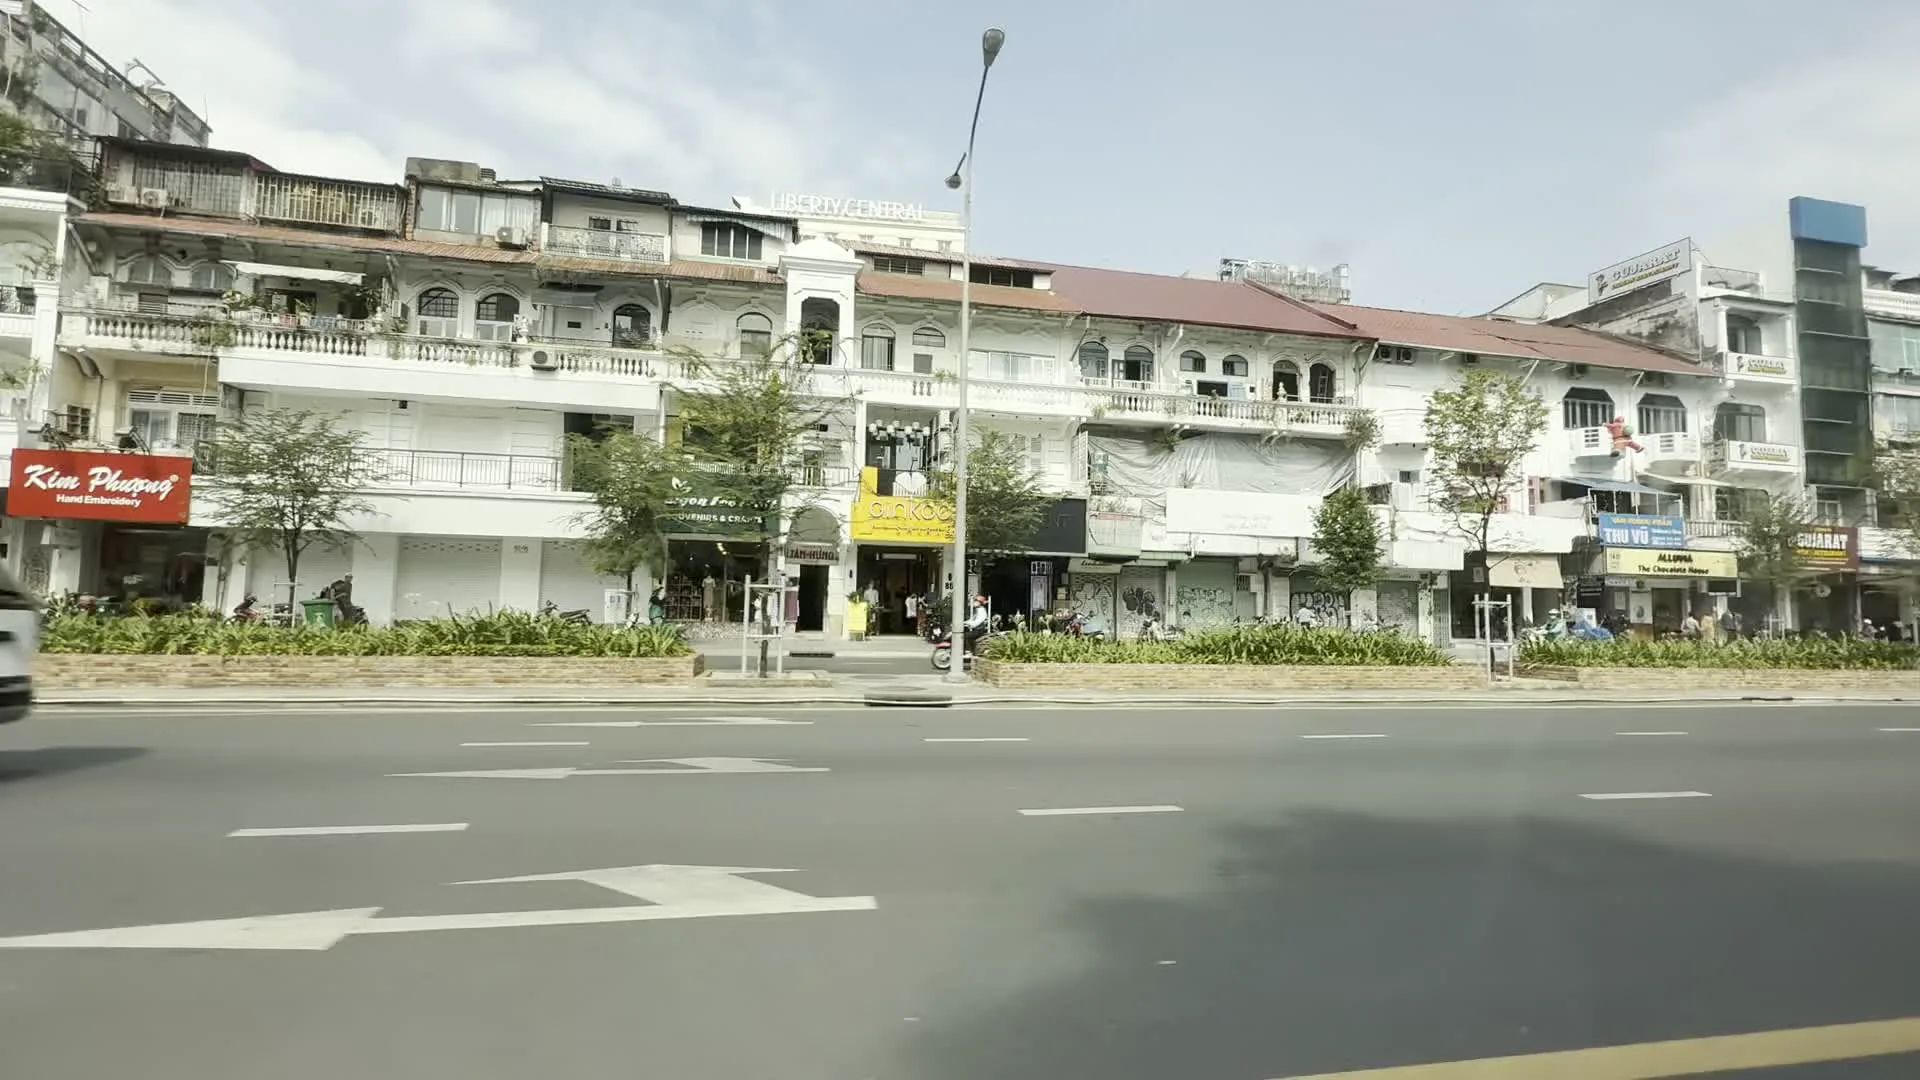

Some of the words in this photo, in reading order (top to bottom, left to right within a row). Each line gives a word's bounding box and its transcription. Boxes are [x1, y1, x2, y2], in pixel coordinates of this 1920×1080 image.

[770, 191, 841, 215] LIBERTY
[24, 464, 81, 490] Kim
[56, 494, 83, 504] Hand
[84, 495, 142, 508] Embroidery
[1602, 527, 1629, 544] THU
[1797, 532, 1849, 550] GUJARAT
